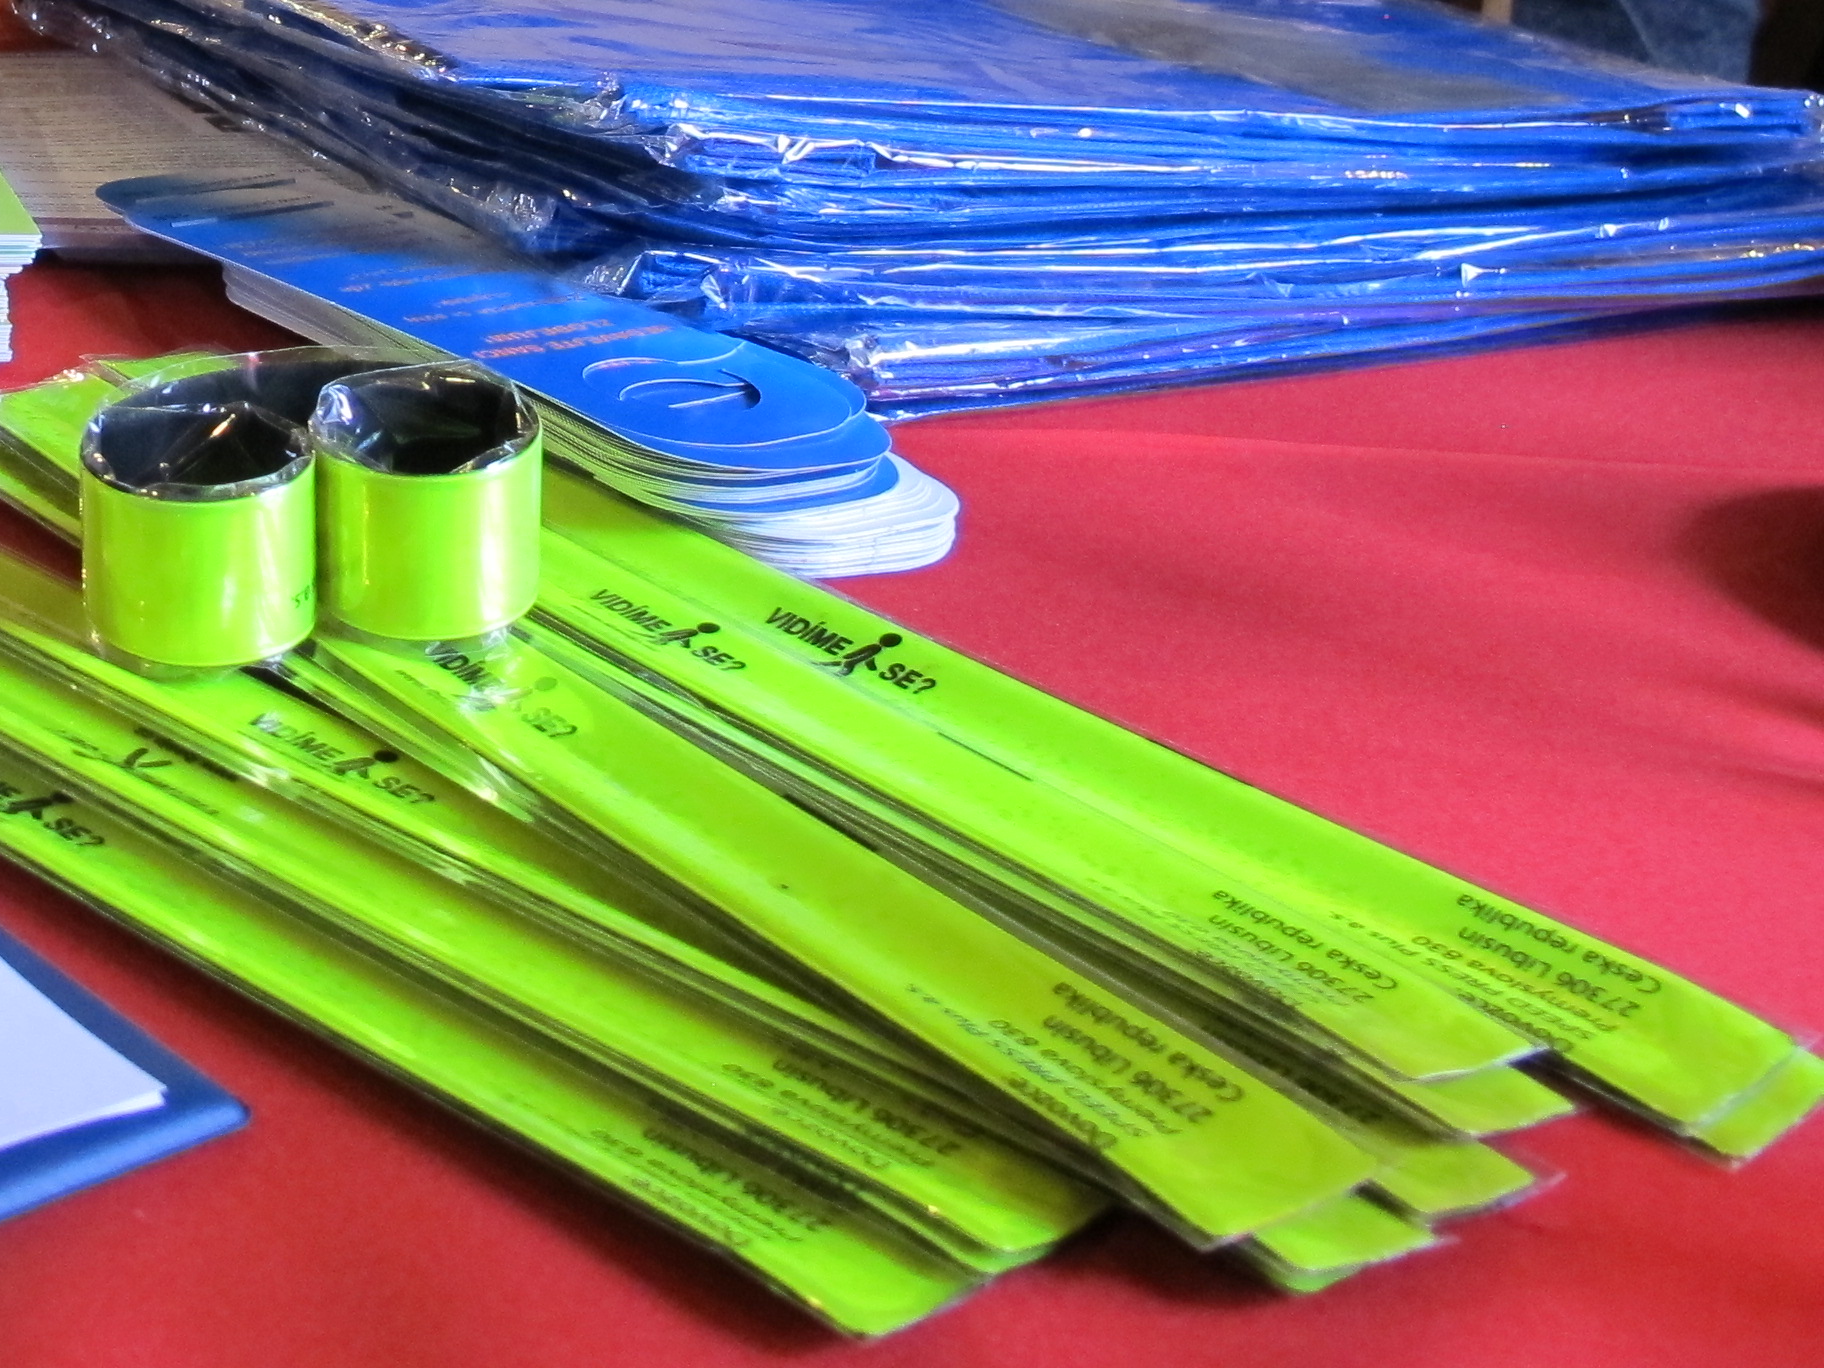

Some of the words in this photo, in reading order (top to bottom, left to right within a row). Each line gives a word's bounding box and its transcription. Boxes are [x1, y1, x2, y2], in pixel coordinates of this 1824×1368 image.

[590, 588, 673, 633] VIDÍME
[691, 645, 747, 672] SE?
[765, 606, 855, 656] VIDÍME
[879, 662, 937, 695] SE?
[373, 776, 436, 804] SE?
[43, 817, 106, 846] SE?
[1211, 889, 1324, 950] republika
[1456, 894, 1582, 954] republika
[1365, 931, 1422, 957] Plus
[1411, 935, 1463, 961] 830
[1296, 960, 1374, 1003] 27306
[1419, 956, 1505, 997] PRESS
[1555, 971, 1642, 1018] 27306
[1507, 996, 1594, 1040] SPEED
